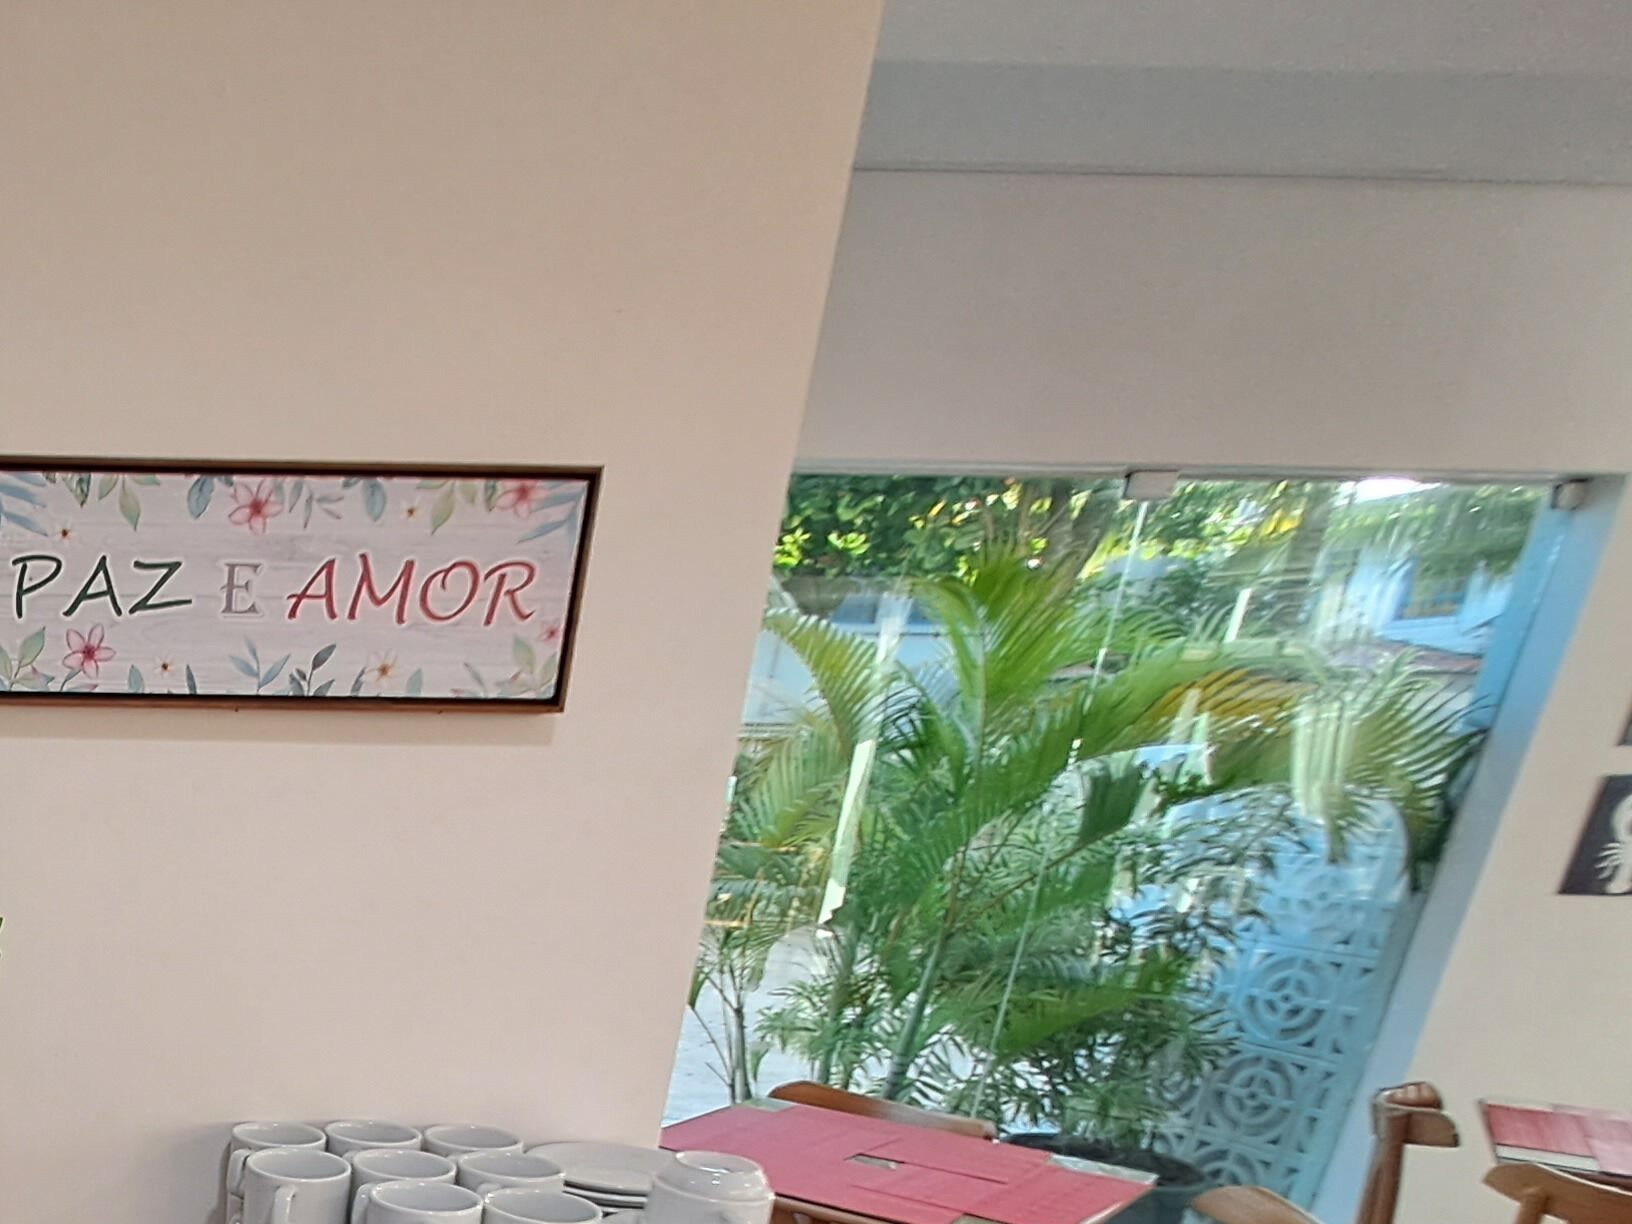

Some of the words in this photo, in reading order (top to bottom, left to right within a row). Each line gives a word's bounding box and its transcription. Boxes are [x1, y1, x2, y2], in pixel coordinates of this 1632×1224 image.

[12, 555, 192, 618] PAZ
[220, 562, 264, 615] E
[287, 553, 537, 627] AMOR
